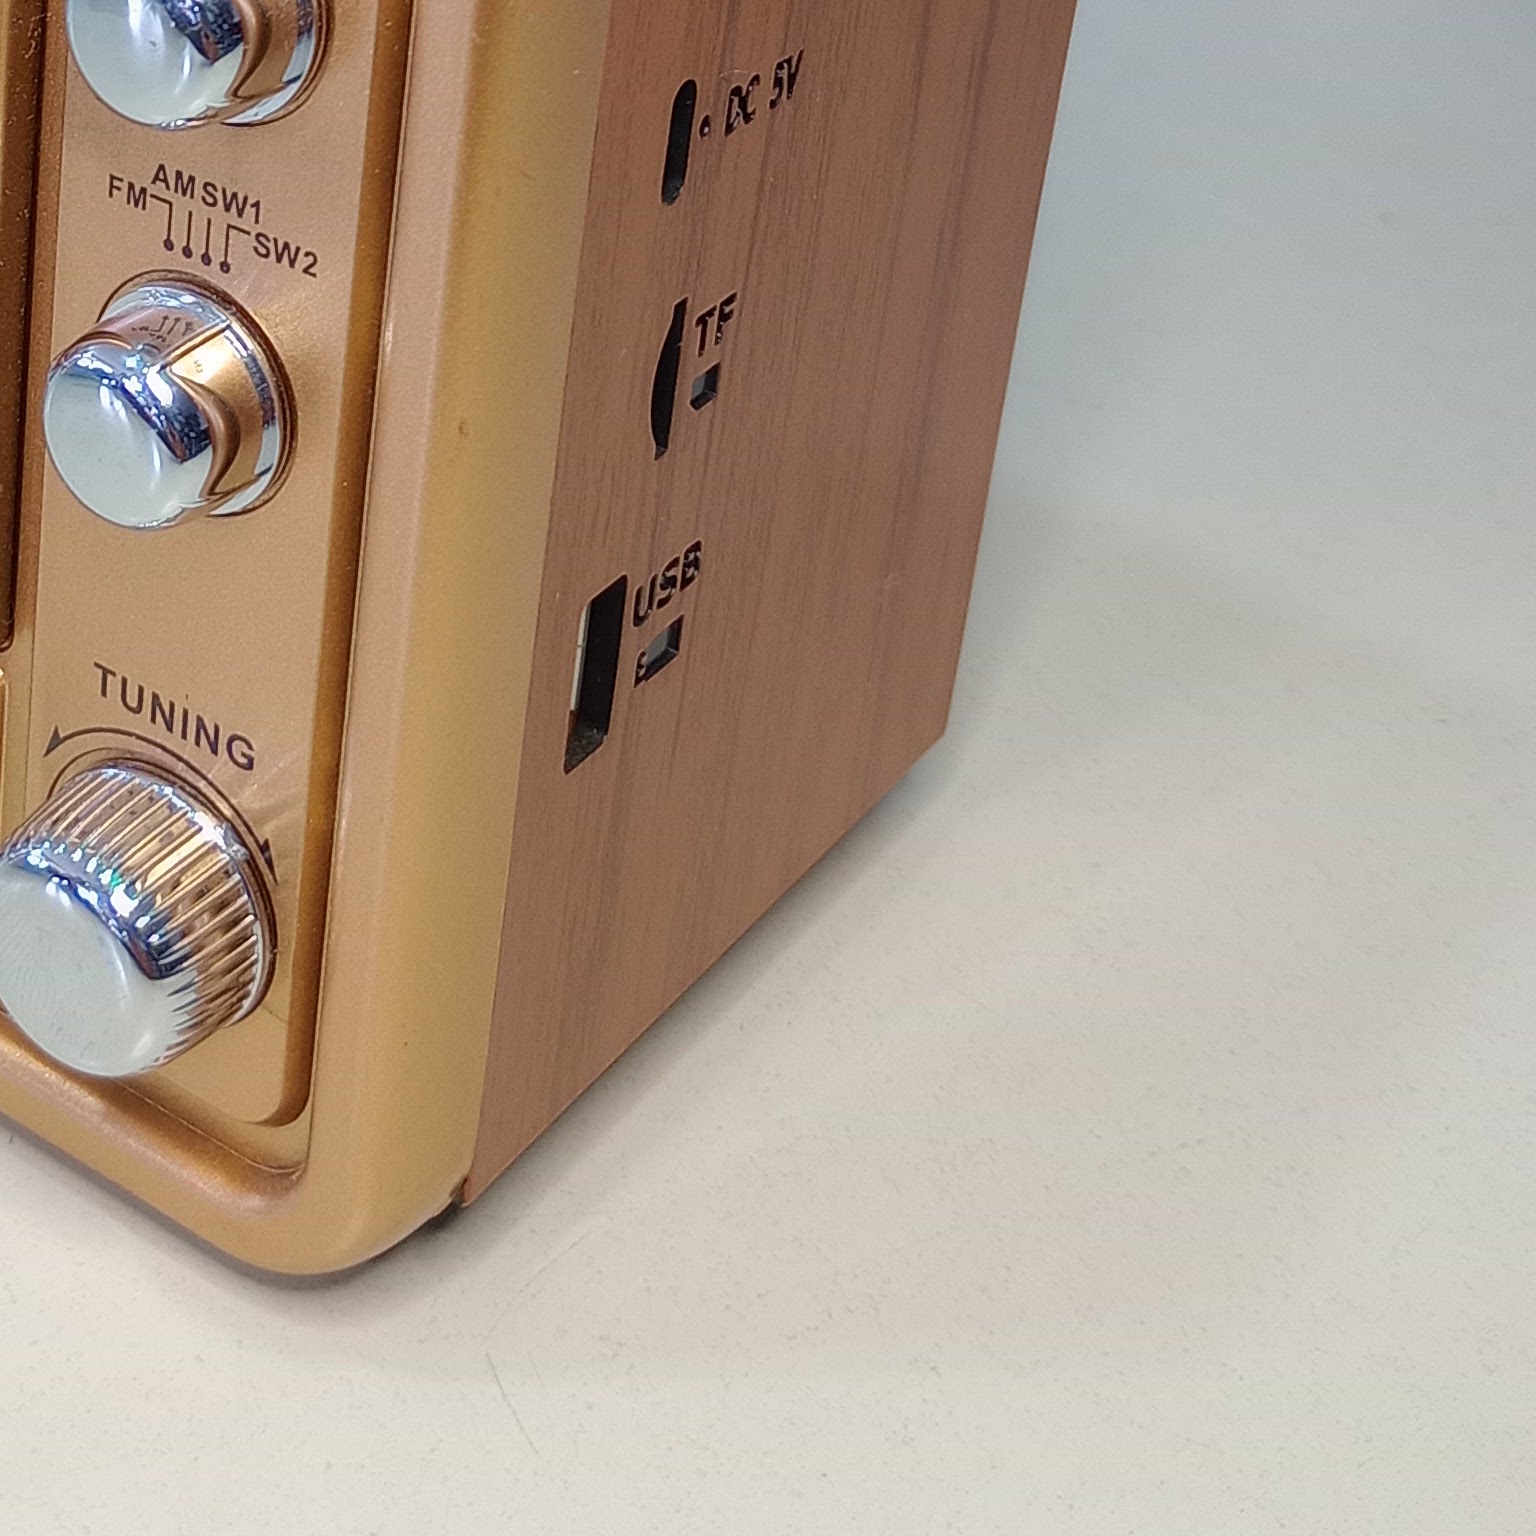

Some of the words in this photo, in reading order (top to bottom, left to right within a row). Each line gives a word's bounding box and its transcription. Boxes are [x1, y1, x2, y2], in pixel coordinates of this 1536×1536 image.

[724, 73, 761, 137] DC
[769, 49, 805, 109] 5V
[108, 173, 148, 210] FM
[151, 163, 196, 199] AM
[201, 181, 261, 224] SW1
[253, 232, 319, 278] SW2
[694, 290, 738, 358] TF
[632, 539, 703, 628] USB
[93, 661, 256, 771] TUNING
